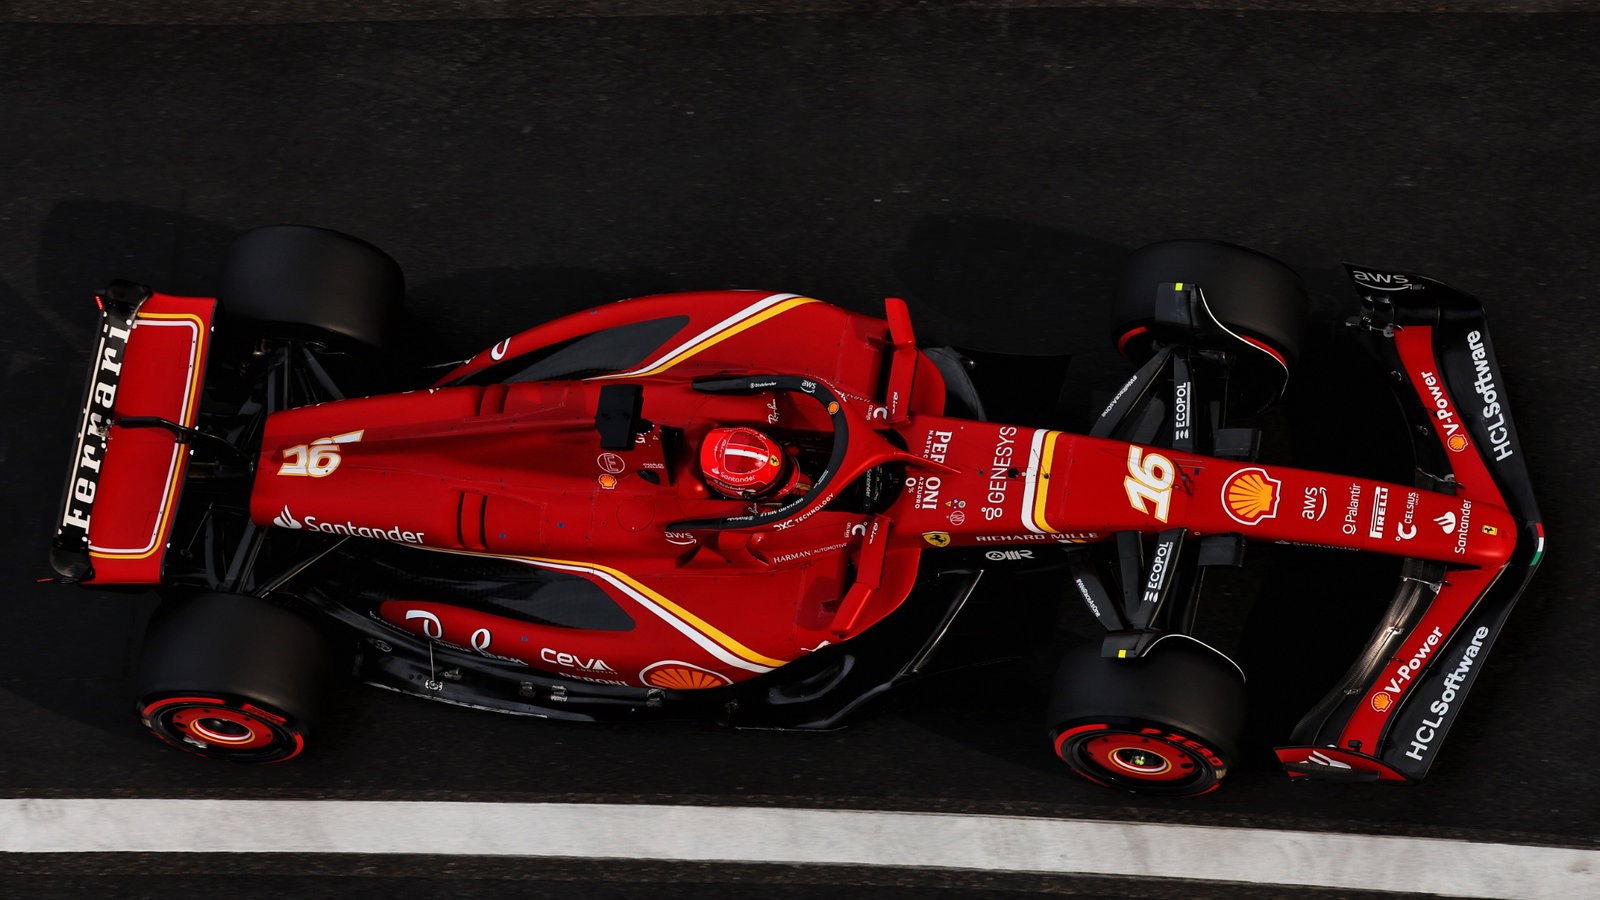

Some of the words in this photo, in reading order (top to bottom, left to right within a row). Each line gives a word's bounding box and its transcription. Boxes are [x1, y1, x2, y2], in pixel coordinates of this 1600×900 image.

[1353, 270, 1409, 285] aws
[801, 379, 817, 390] aws
[1175, 382, 1187, 428] ECOPOL
[1421, 371, 1460, 436] V-Power
[1466, 329, 1514, 462] HCLSoftware
[62, 323, 132, 535] Ferrari
[276, 429, 365, 478] 16
[987, 426, 1017, 504] GENESYS
[720, 471, 756, 483] Santander
[1123, 444, 1176, 524] 16
[773, 519, 796, 532] DXC
[794, 493, 834, 524] TECHNOLOGY
[1302, 486, 1319, 520] aws
[1345, 483, 1361, 523] Palantir
[1369, 486, 1389, 539] PIRELLI
[1404, 491, 1416, 525] CELSIUS
[304, 515, 425, 544] Santander
[664, 531, 695, 541] aws
[976, 533, 1046, 542] RICHARD
[1051, 532, 1099, 540] MILLE
[1454, 499, 1472, 555] Santander
[773, 550, 811, 564] HARMAN
[814, 541, 847, 555] AUTOMOTIVE
[1147, 541, 1170, 589] ECOPOL
[1384, 626, 1444, 694] V-Power
[1405, 626, 1490, 761] HCLSoftware
[1163, 732, 1224, 767] ZERO
